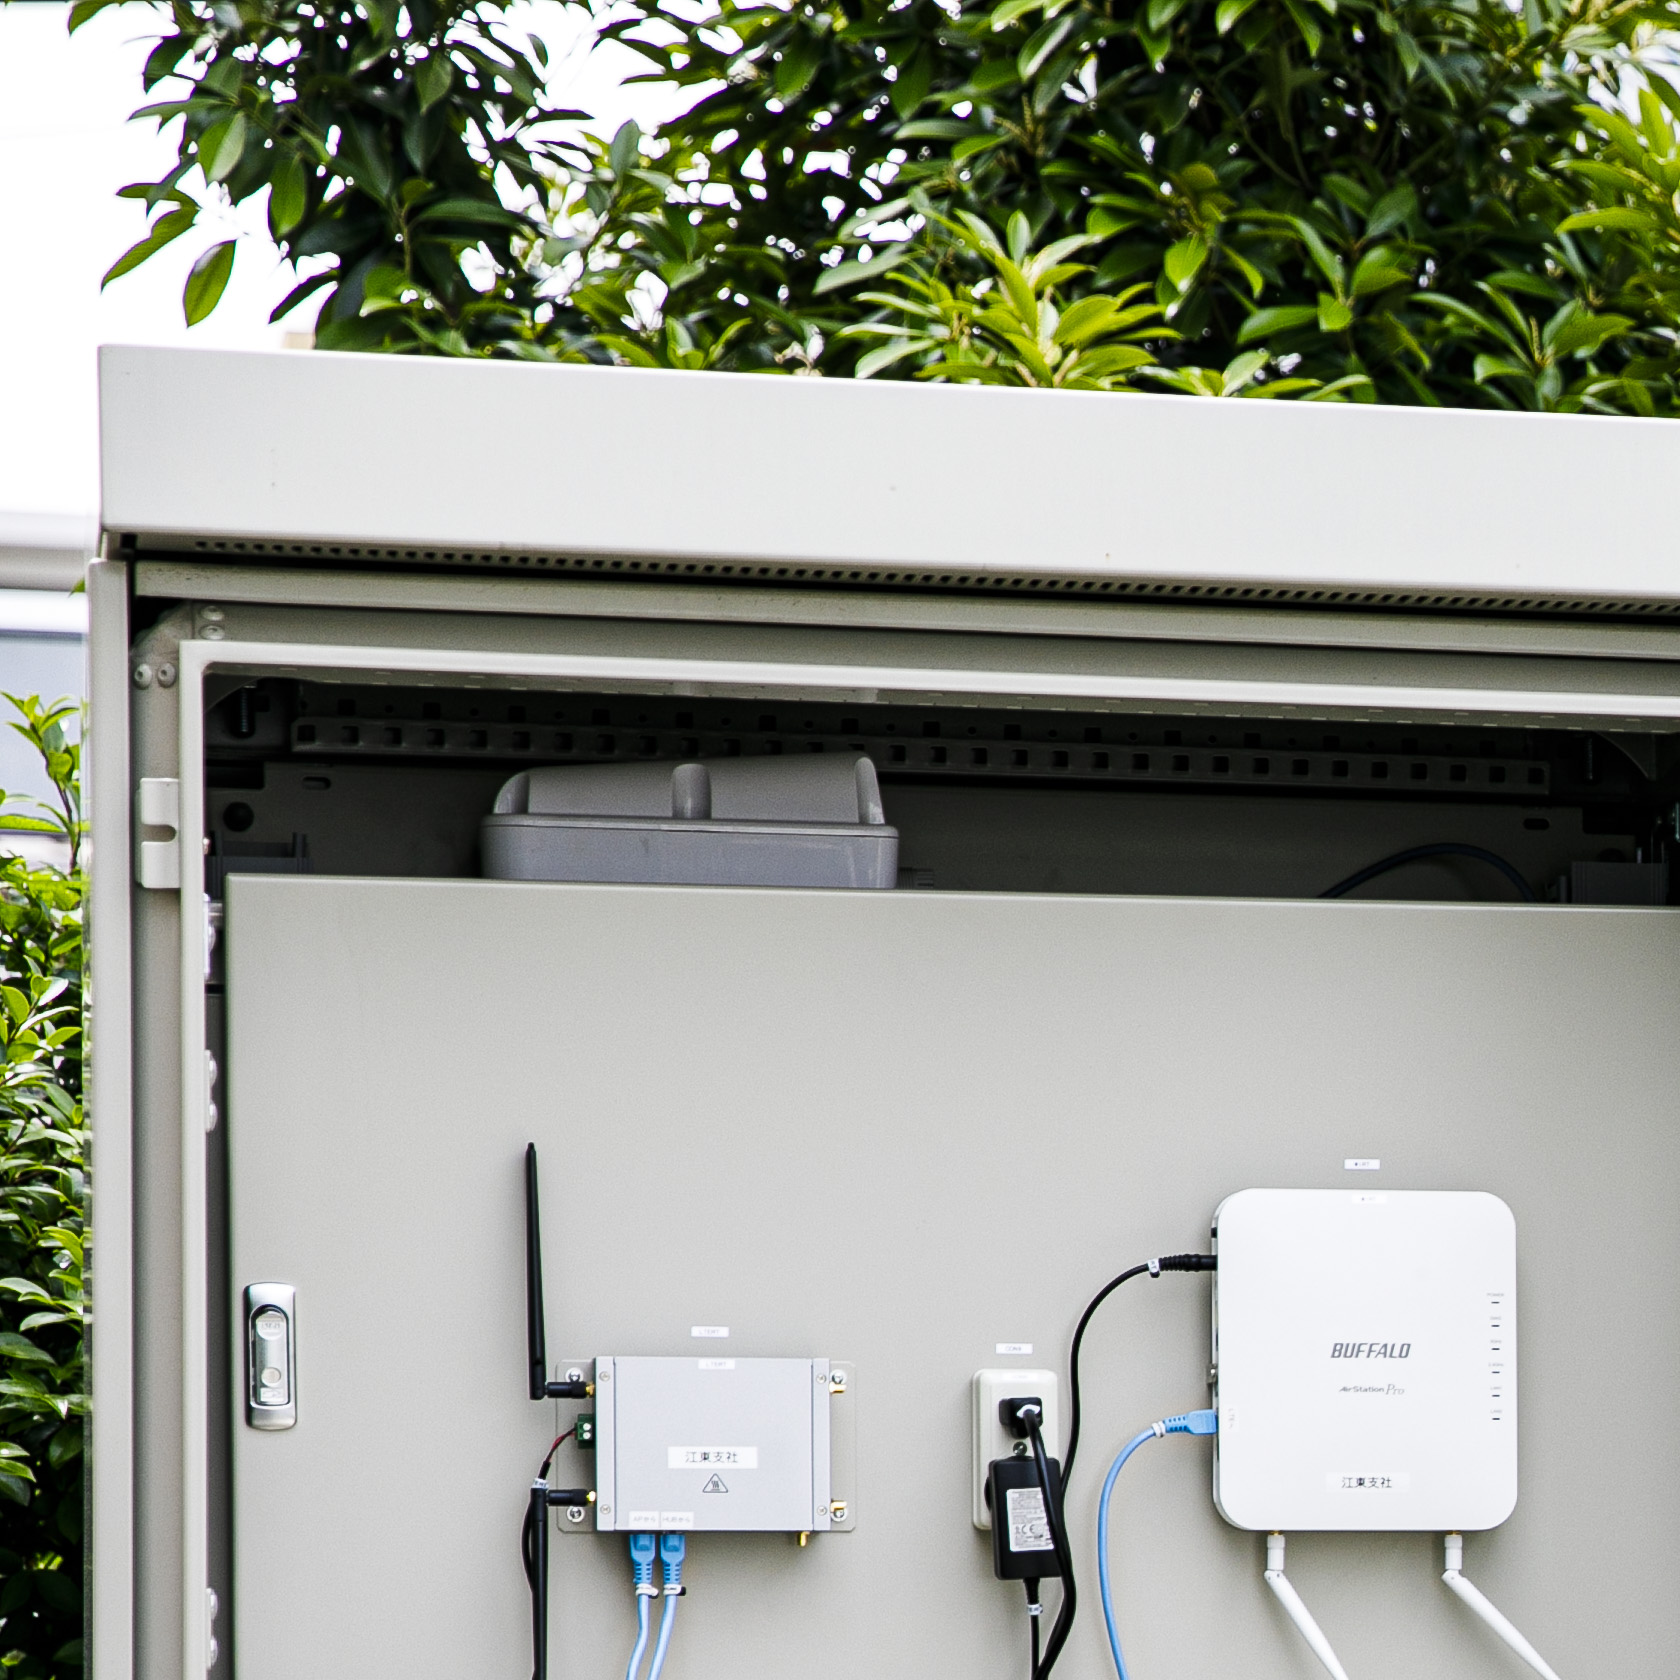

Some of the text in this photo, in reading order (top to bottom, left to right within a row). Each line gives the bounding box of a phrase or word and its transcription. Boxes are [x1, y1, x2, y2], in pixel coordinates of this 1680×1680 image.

[1330, 1342, 1412, 1359] BUFFALO
[1338, 1383, 1405, 1395] AirStation Pro
[685, 1451, 739, 1464] 江東支社
[1341, 1476, 1393, 1489] 江東支社
